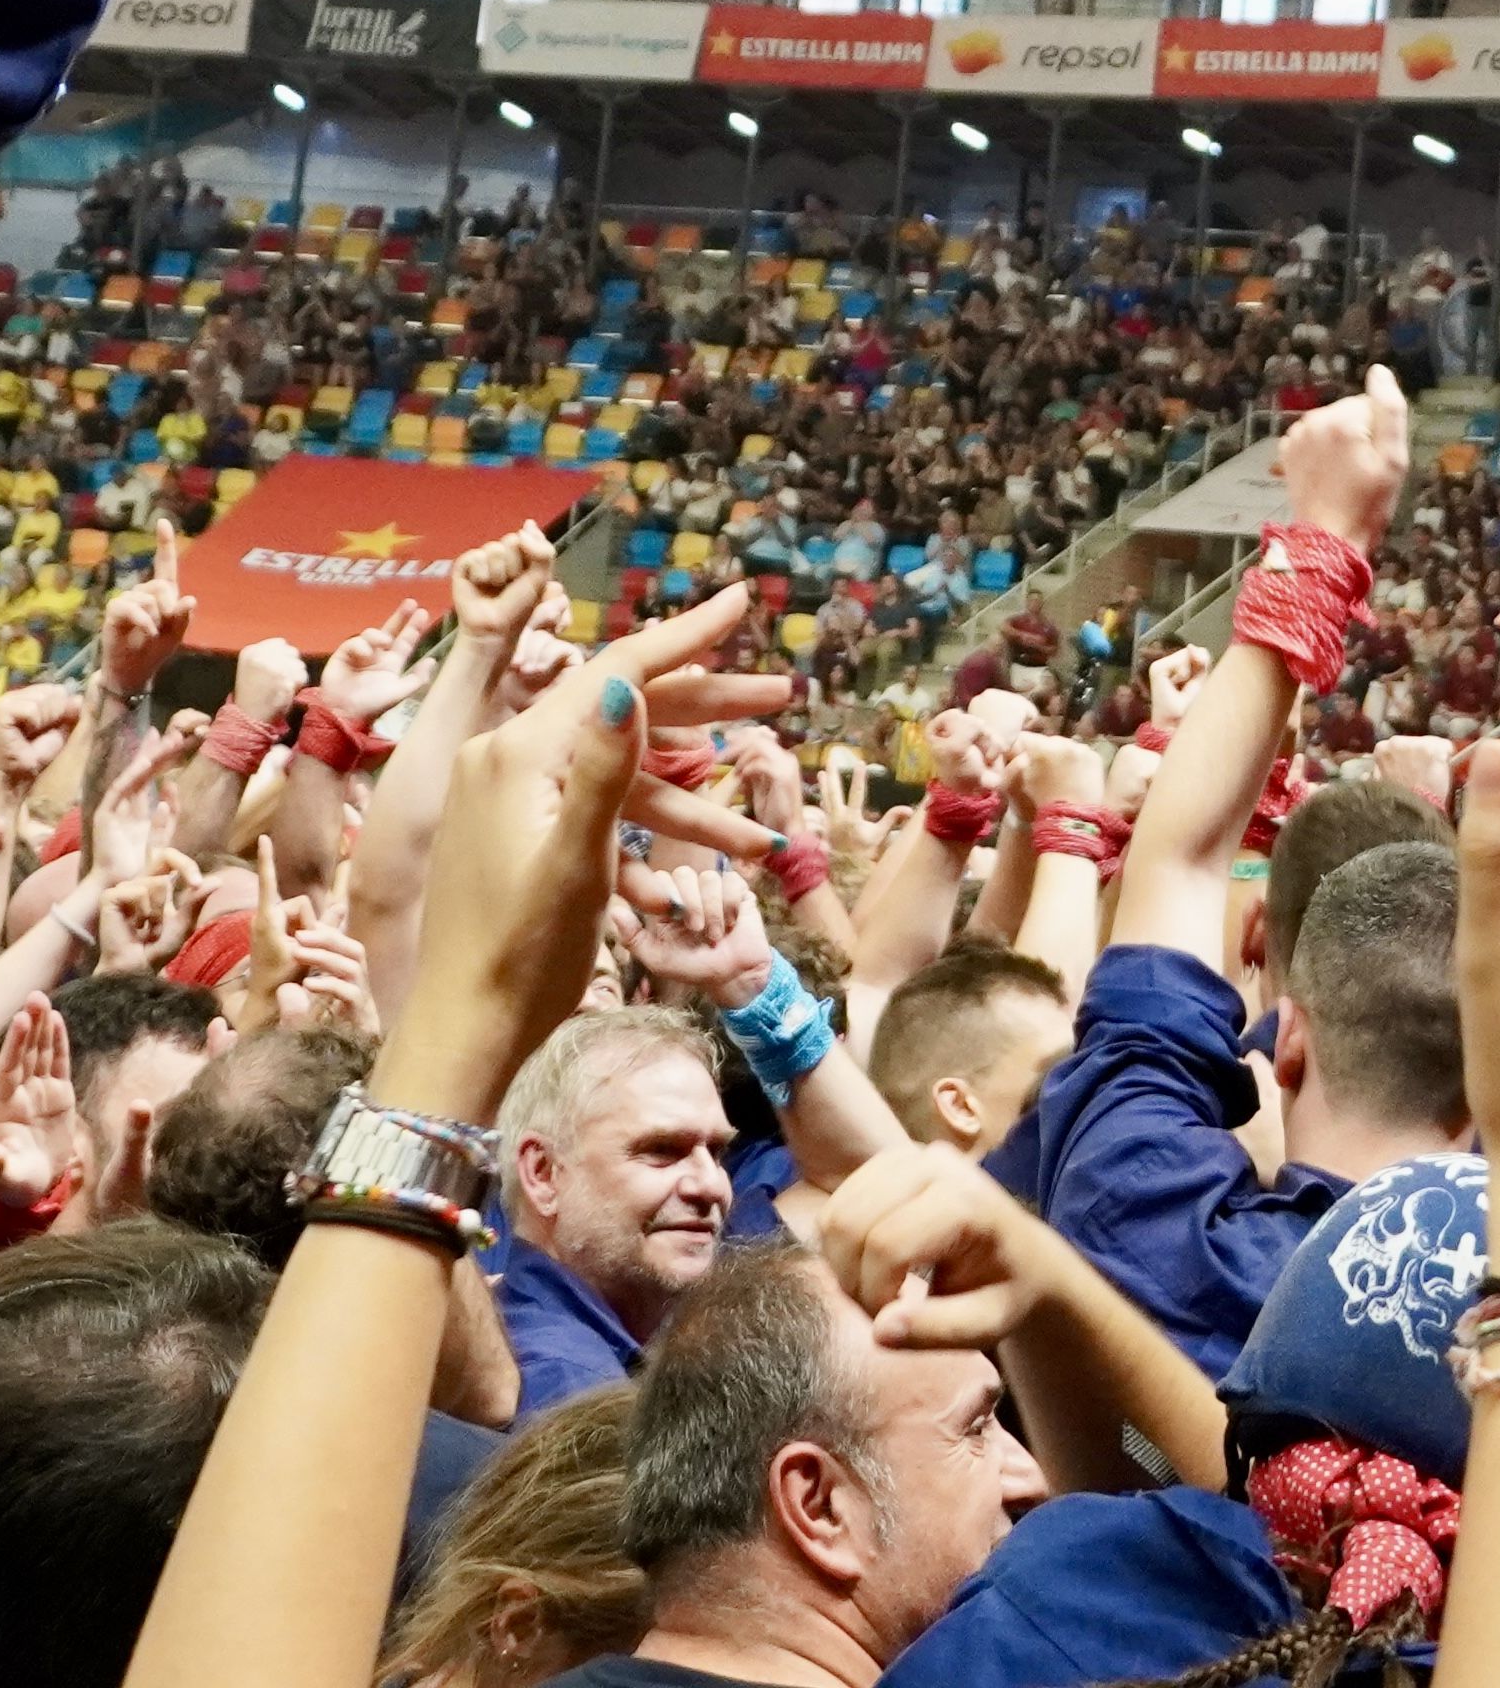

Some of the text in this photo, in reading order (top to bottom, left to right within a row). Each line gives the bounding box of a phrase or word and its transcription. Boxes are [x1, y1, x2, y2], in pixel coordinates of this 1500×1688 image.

[739, 36, 924, 64] ESTRELLA DAMM
[1020, 41, 1143, 74] repsol
[1193, 48, 1380, 74] ESTRELLA DAMM
[240, 547, 455, 580] ESTRELLA
